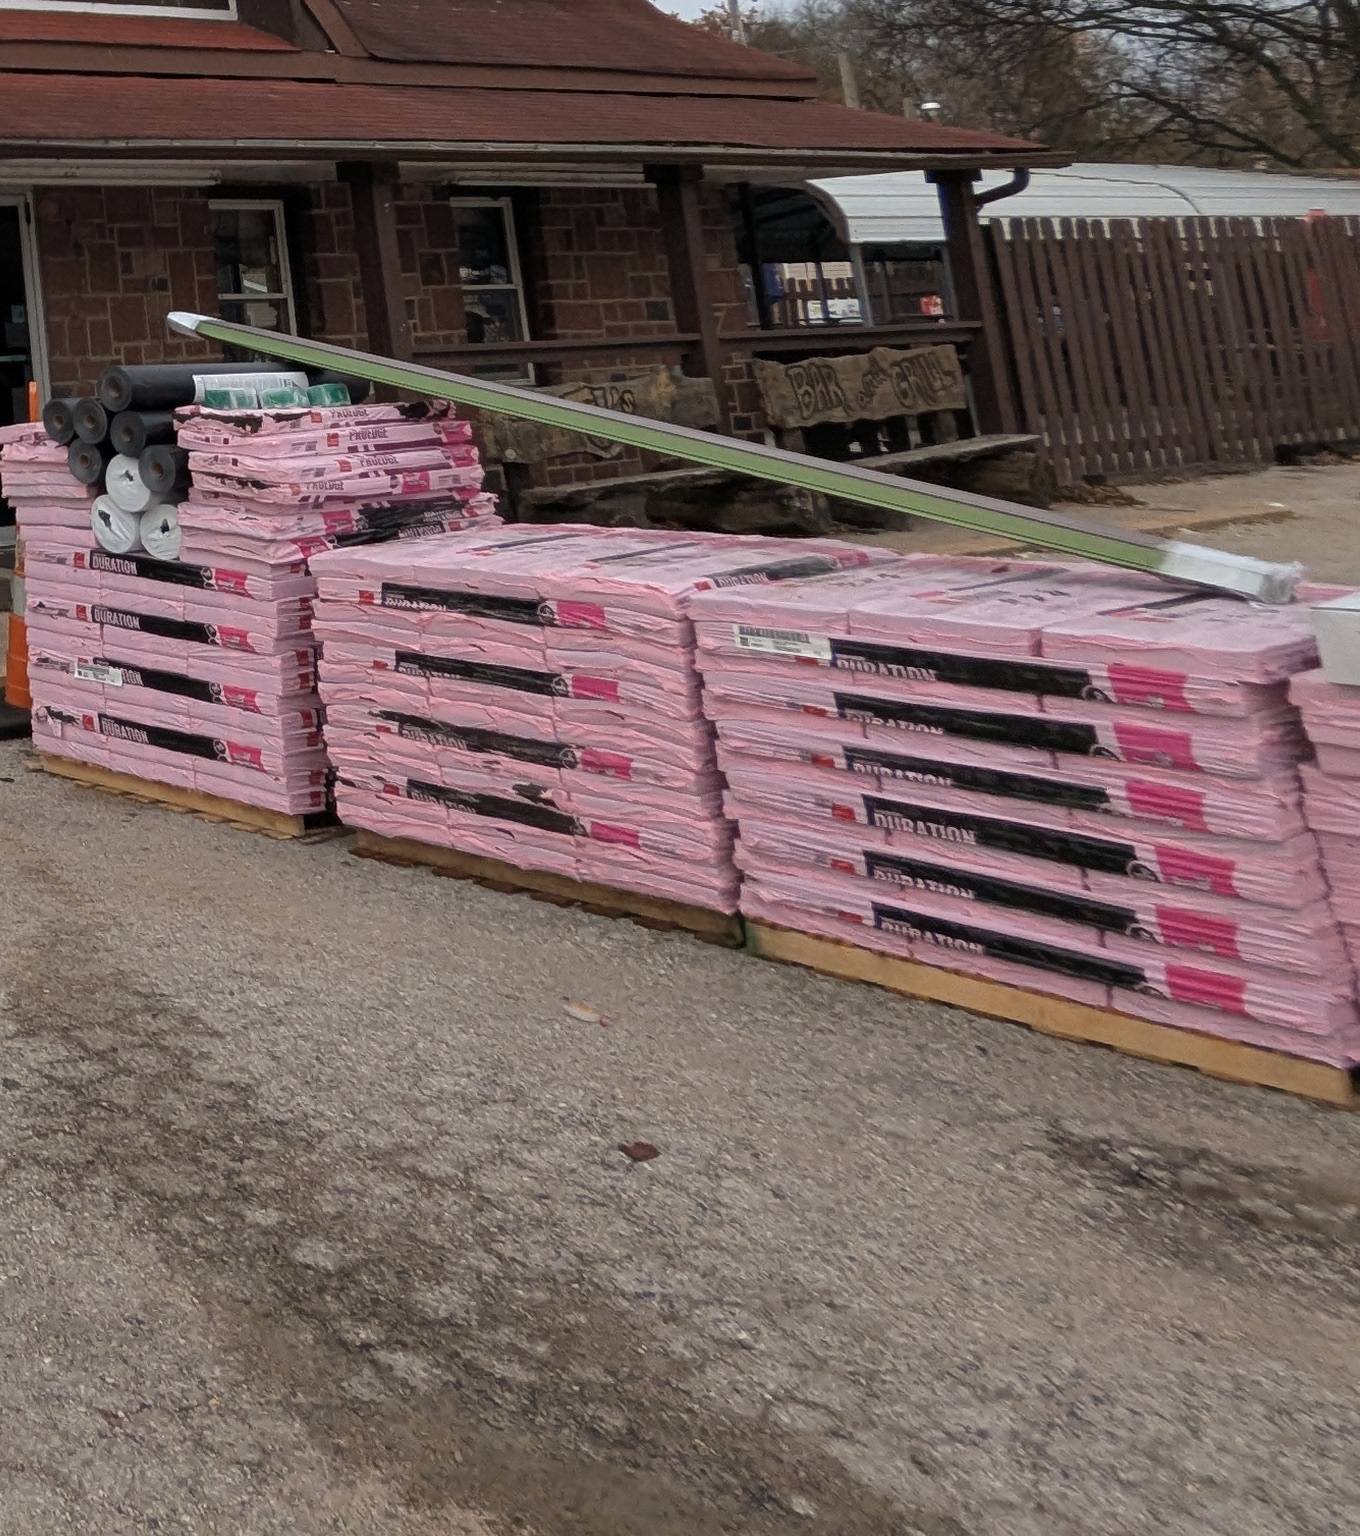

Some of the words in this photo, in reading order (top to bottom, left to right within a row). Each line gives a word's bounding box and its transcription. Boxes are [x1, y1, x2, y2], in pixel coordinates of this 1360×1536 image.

[785, 362, 855, 420] BAR
[891, 351, 957, 409] GRILL
[92, 555, 138, 575] DURATION
[94, 608, 141, 630] DURATION
[101, 720, 150, 745] DURATION
[874, 813, 977, 845] DURATION
